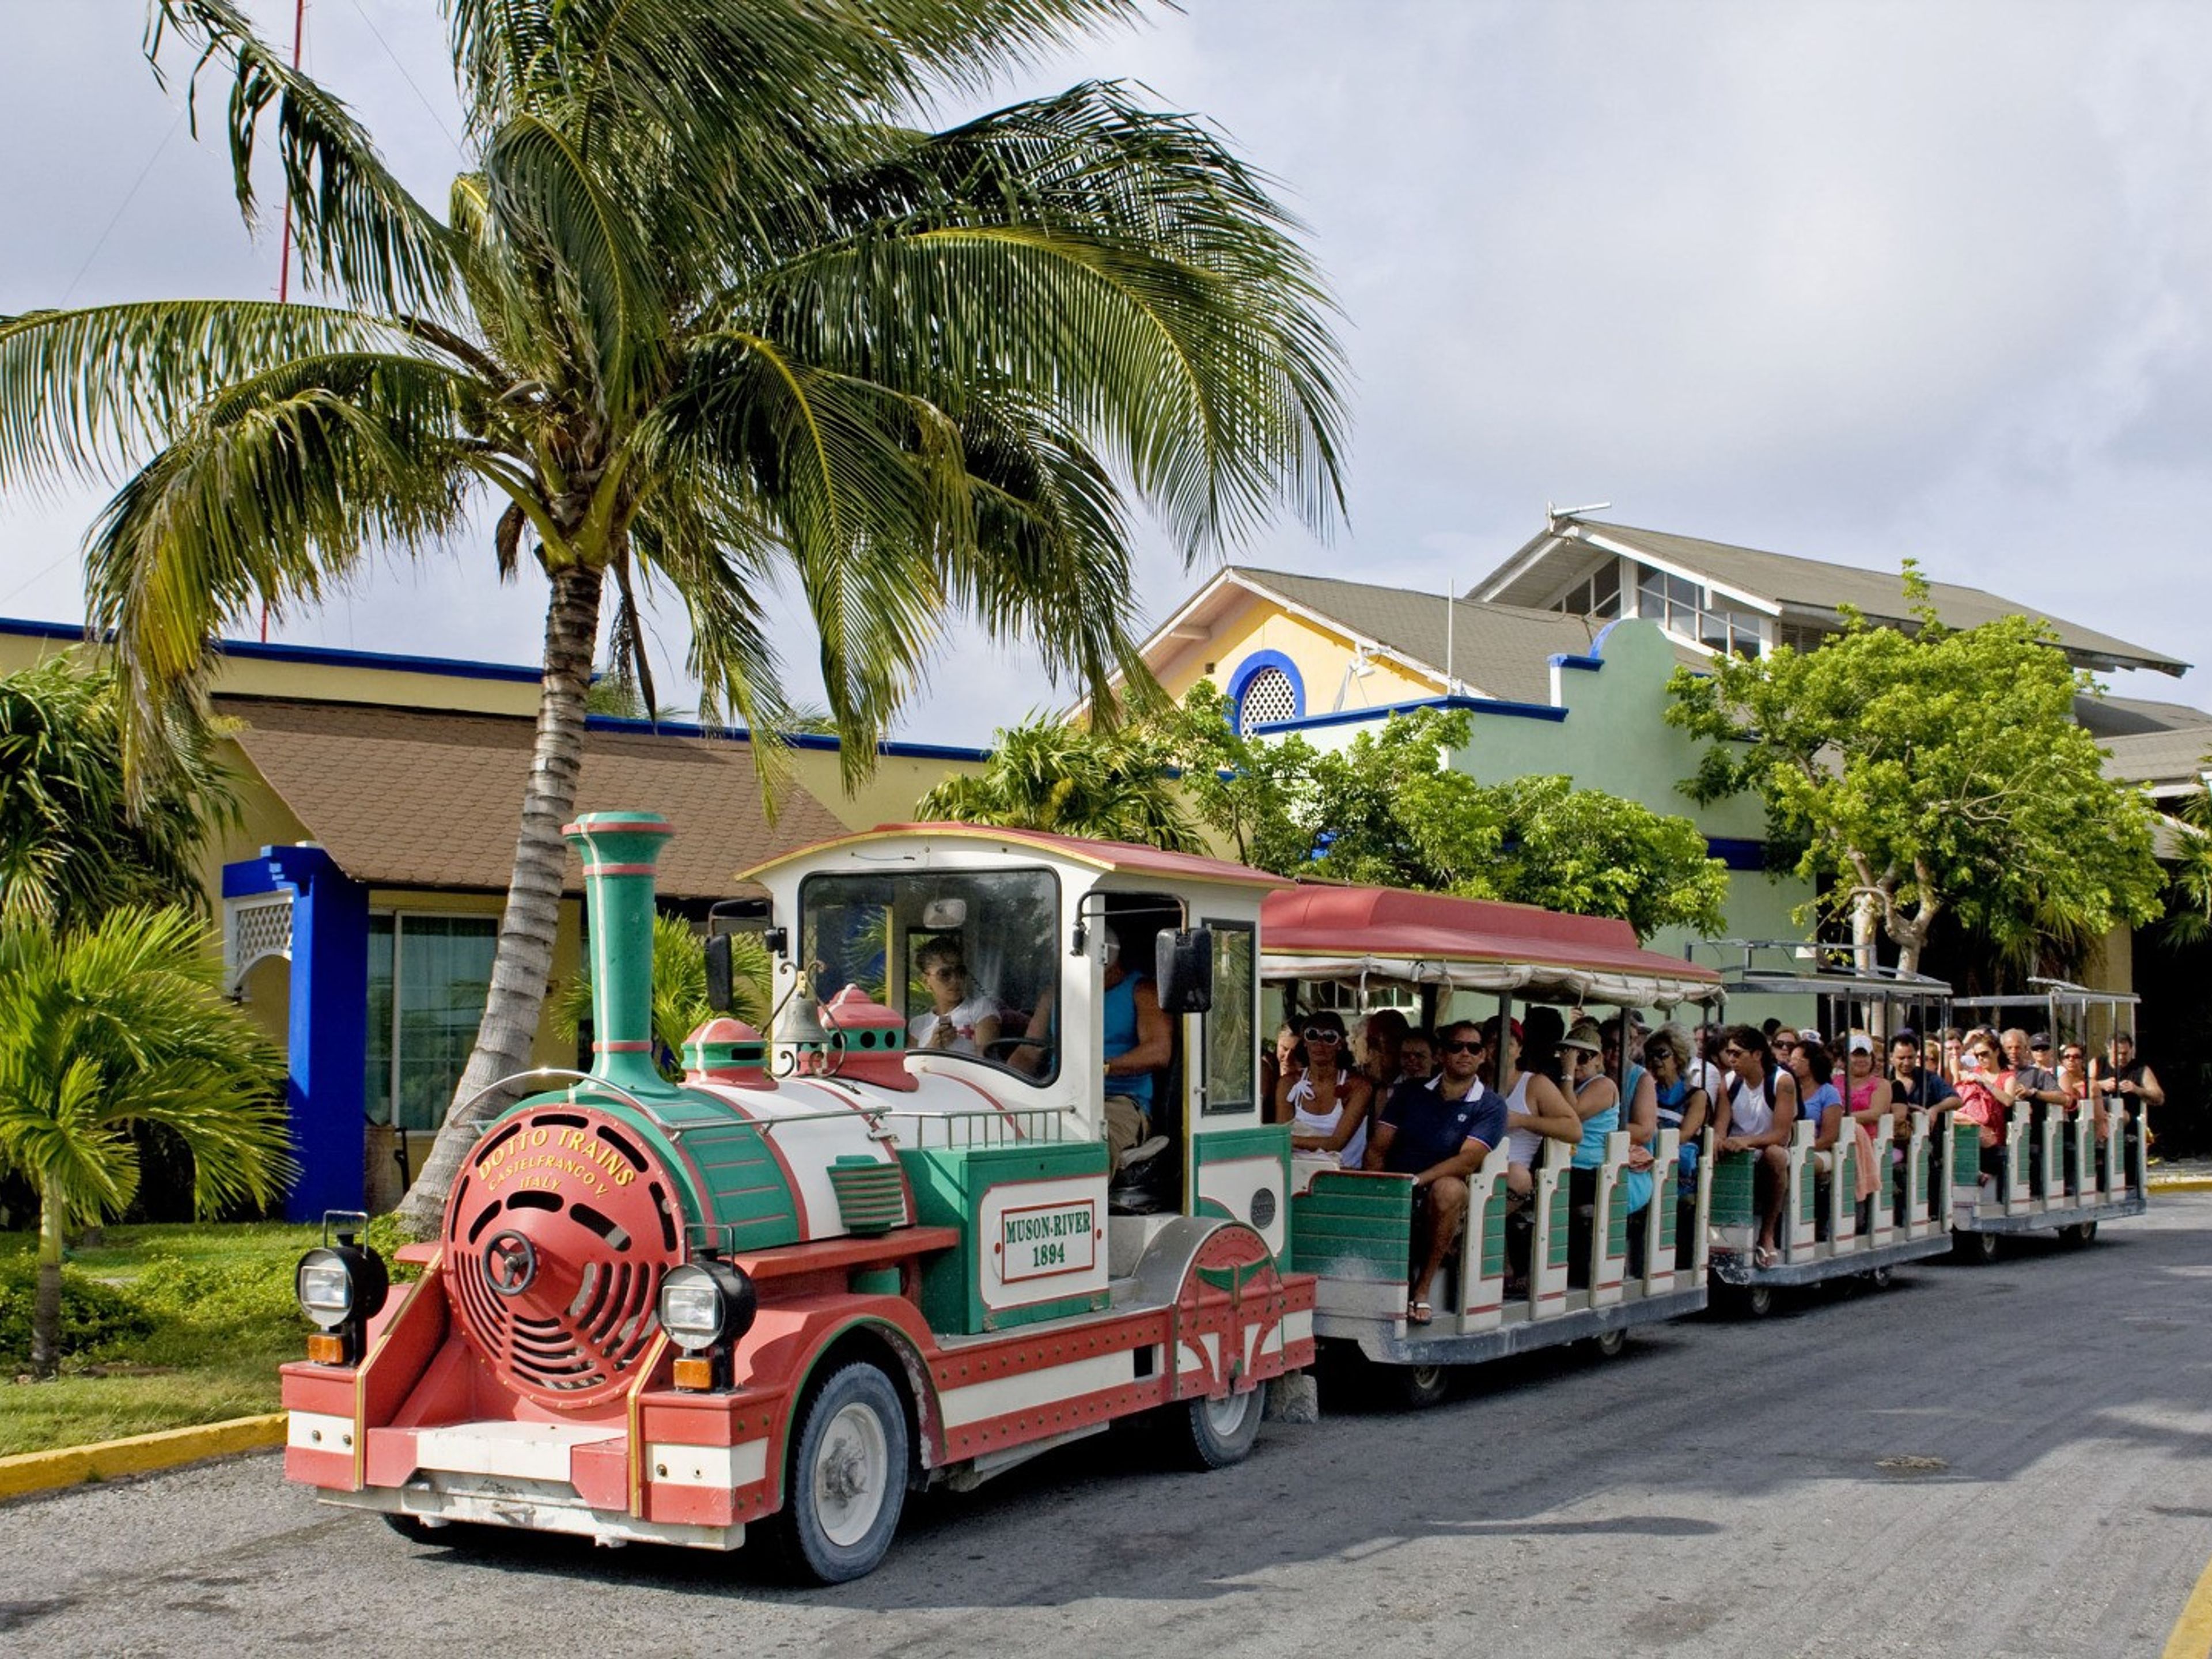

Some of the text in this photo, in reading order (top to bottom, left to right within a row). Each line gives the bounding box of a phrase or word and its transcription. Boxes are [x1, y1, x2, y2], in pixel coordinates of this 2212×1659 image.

[479, 1128, 635, 1186] DOTTO TRAINS
[488, 1155, 596, 1190] CASTELFRANCO
[520, 1176, 561, 1190] ITALY
[1033, 1241, 1065, 1267] 1894
